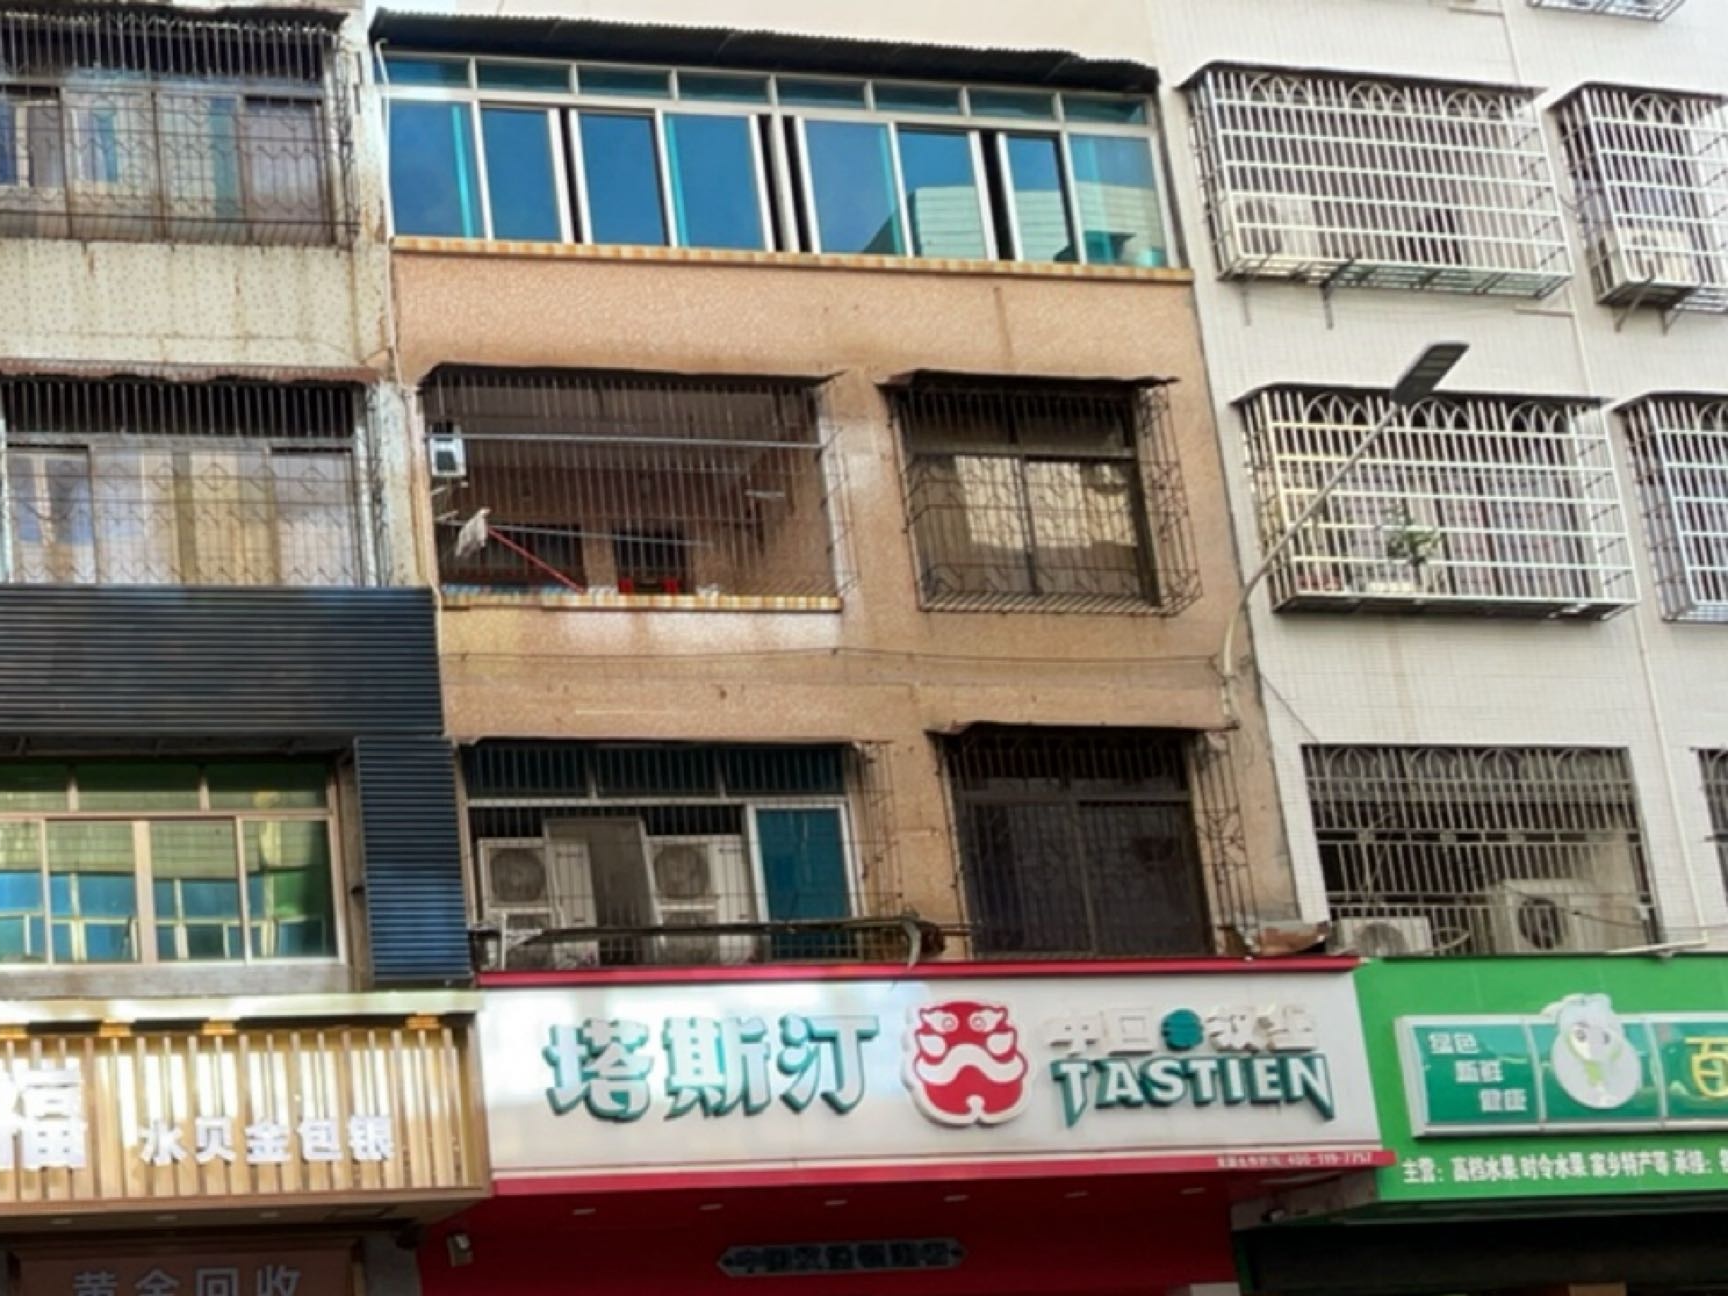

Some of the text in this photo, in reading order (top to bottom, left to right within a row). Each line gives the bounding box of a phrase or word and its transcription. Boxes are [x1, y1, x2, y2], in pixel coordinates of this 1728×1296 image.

[545, 1010, 879, 1122] 塔斯汀
[1050, 1053, 1335, 1127] TASTIEN
[139, 1114, 396, 1166] 水贝金包银
